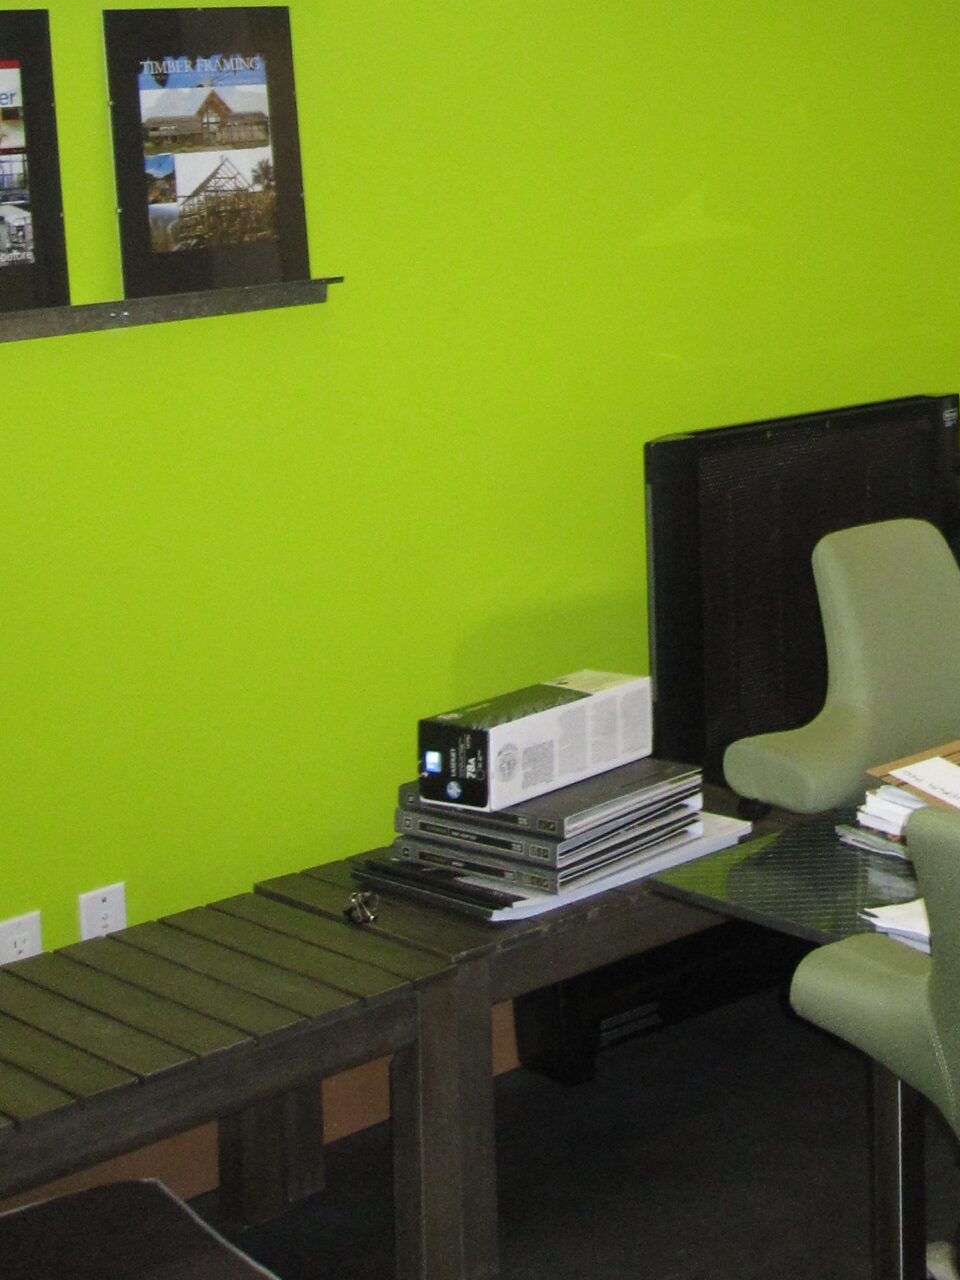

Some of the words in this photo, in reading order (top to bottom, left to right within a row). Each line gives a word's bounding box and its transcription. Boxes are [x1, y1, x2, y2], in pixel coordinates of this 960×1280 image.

[140, 61, 192, 74] TIMBER
[195, 57, 261, 71] FRAMING
[466, 757, 476, 779] 78A
